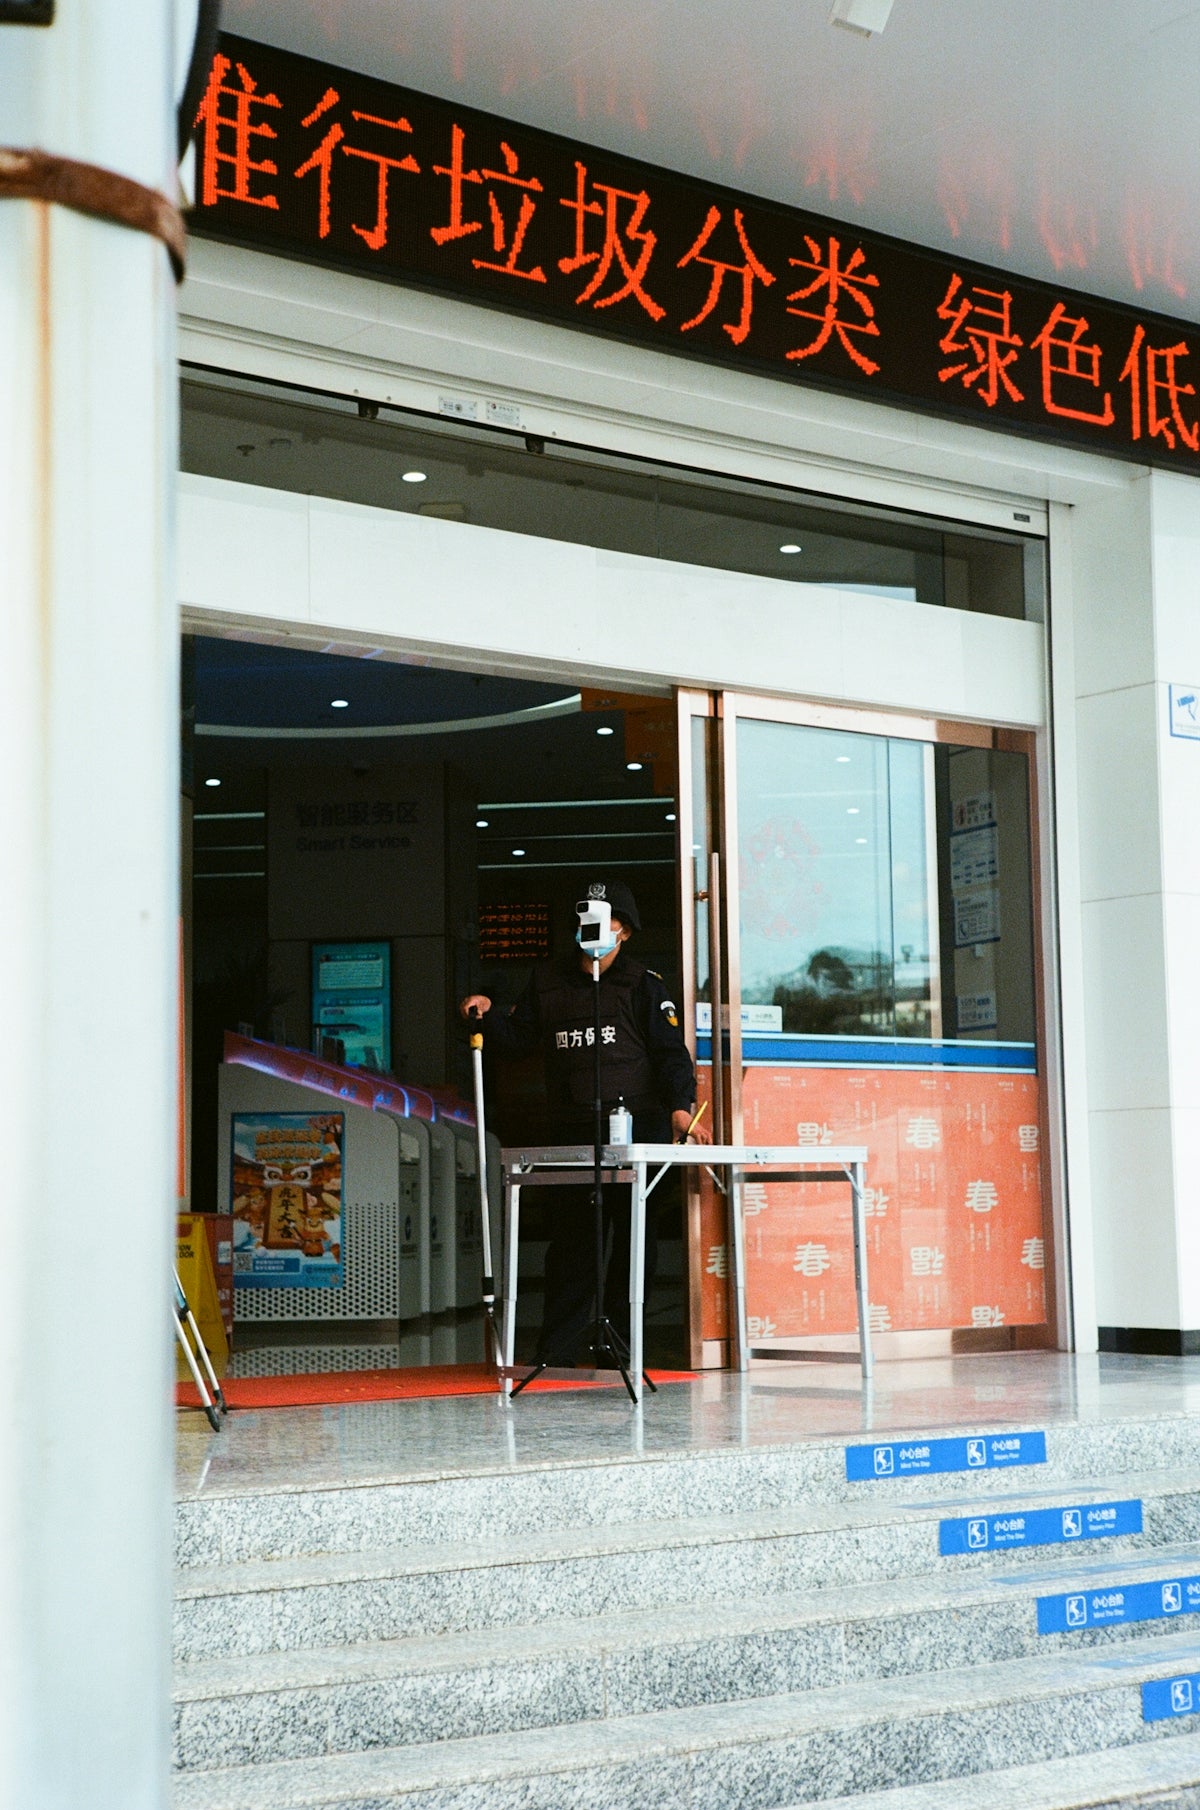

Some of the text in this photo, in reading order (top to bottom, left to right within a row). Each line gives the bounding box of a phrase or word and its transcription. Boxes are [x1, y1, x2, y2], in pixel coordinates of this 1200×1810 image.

[296, 801, 418, 827] 智能服务区
[296, 835, 411, 851] Smart Service
[905, 1115, 940, 1149] 春
[965, 1179, 999, 1213] 春
[793, 1241, 831, 1277] 春
[899, 1446, 930, 1460] 小心台阶
[992, 1439, 1021, 1451] 小心地滑
[1087, 1508, 1117, 1522] 小心地滑
[994, 1518, 1025, 1532] 小心台阶
[1092, 1593, 1124, 1609] 小心台阶
